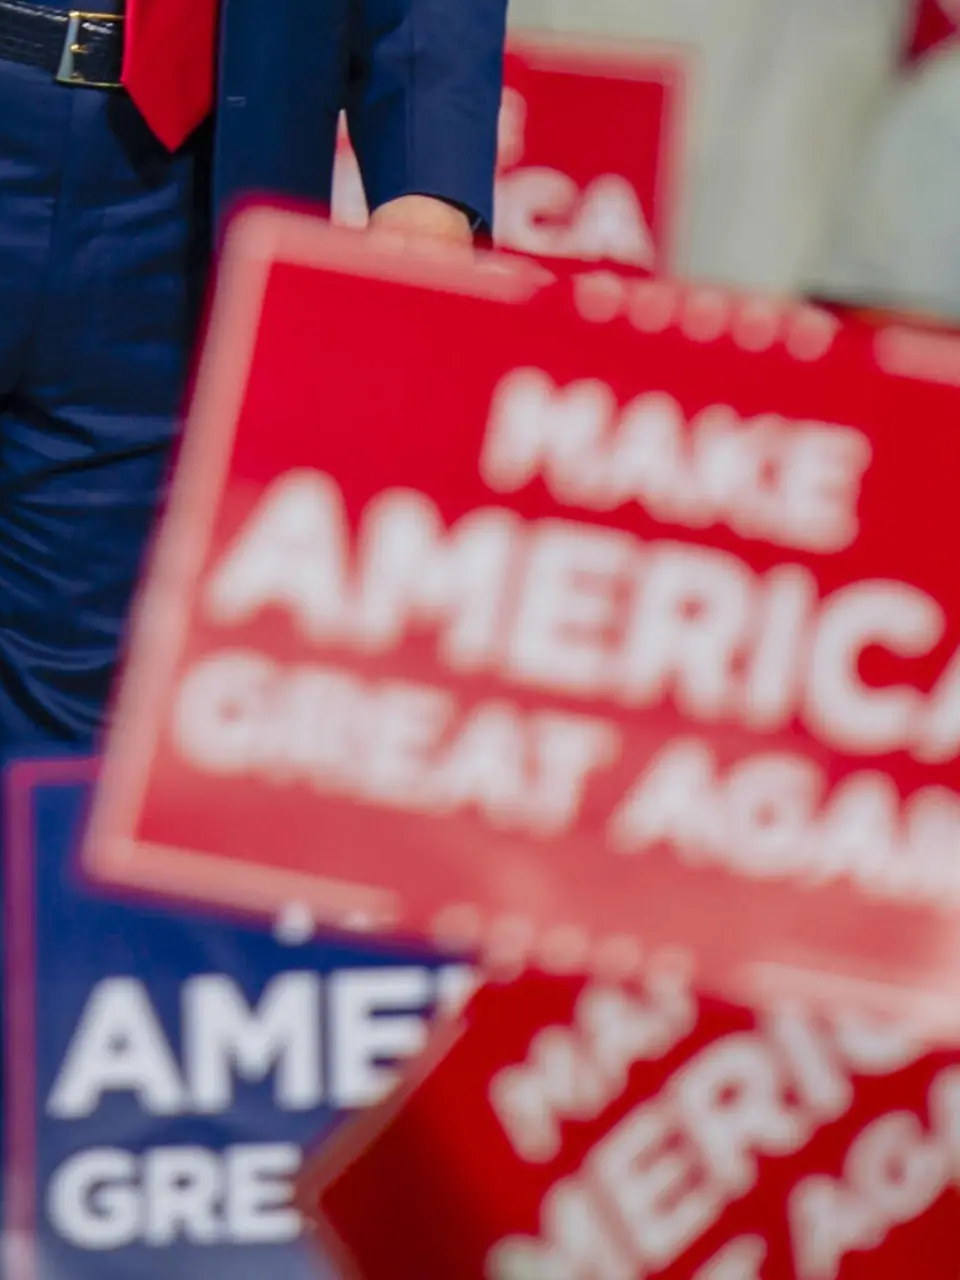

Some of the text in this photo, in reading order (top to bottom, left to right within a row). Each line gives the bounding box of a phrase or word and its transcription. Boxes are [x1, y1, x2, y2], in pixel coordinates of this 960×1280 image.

[486, 370, 868, 548] MAKE
[174, 650, 620, 834] GREAT
[44, 964, 480, 1118] AME
[46, 1142, 304, 1251] GRE
